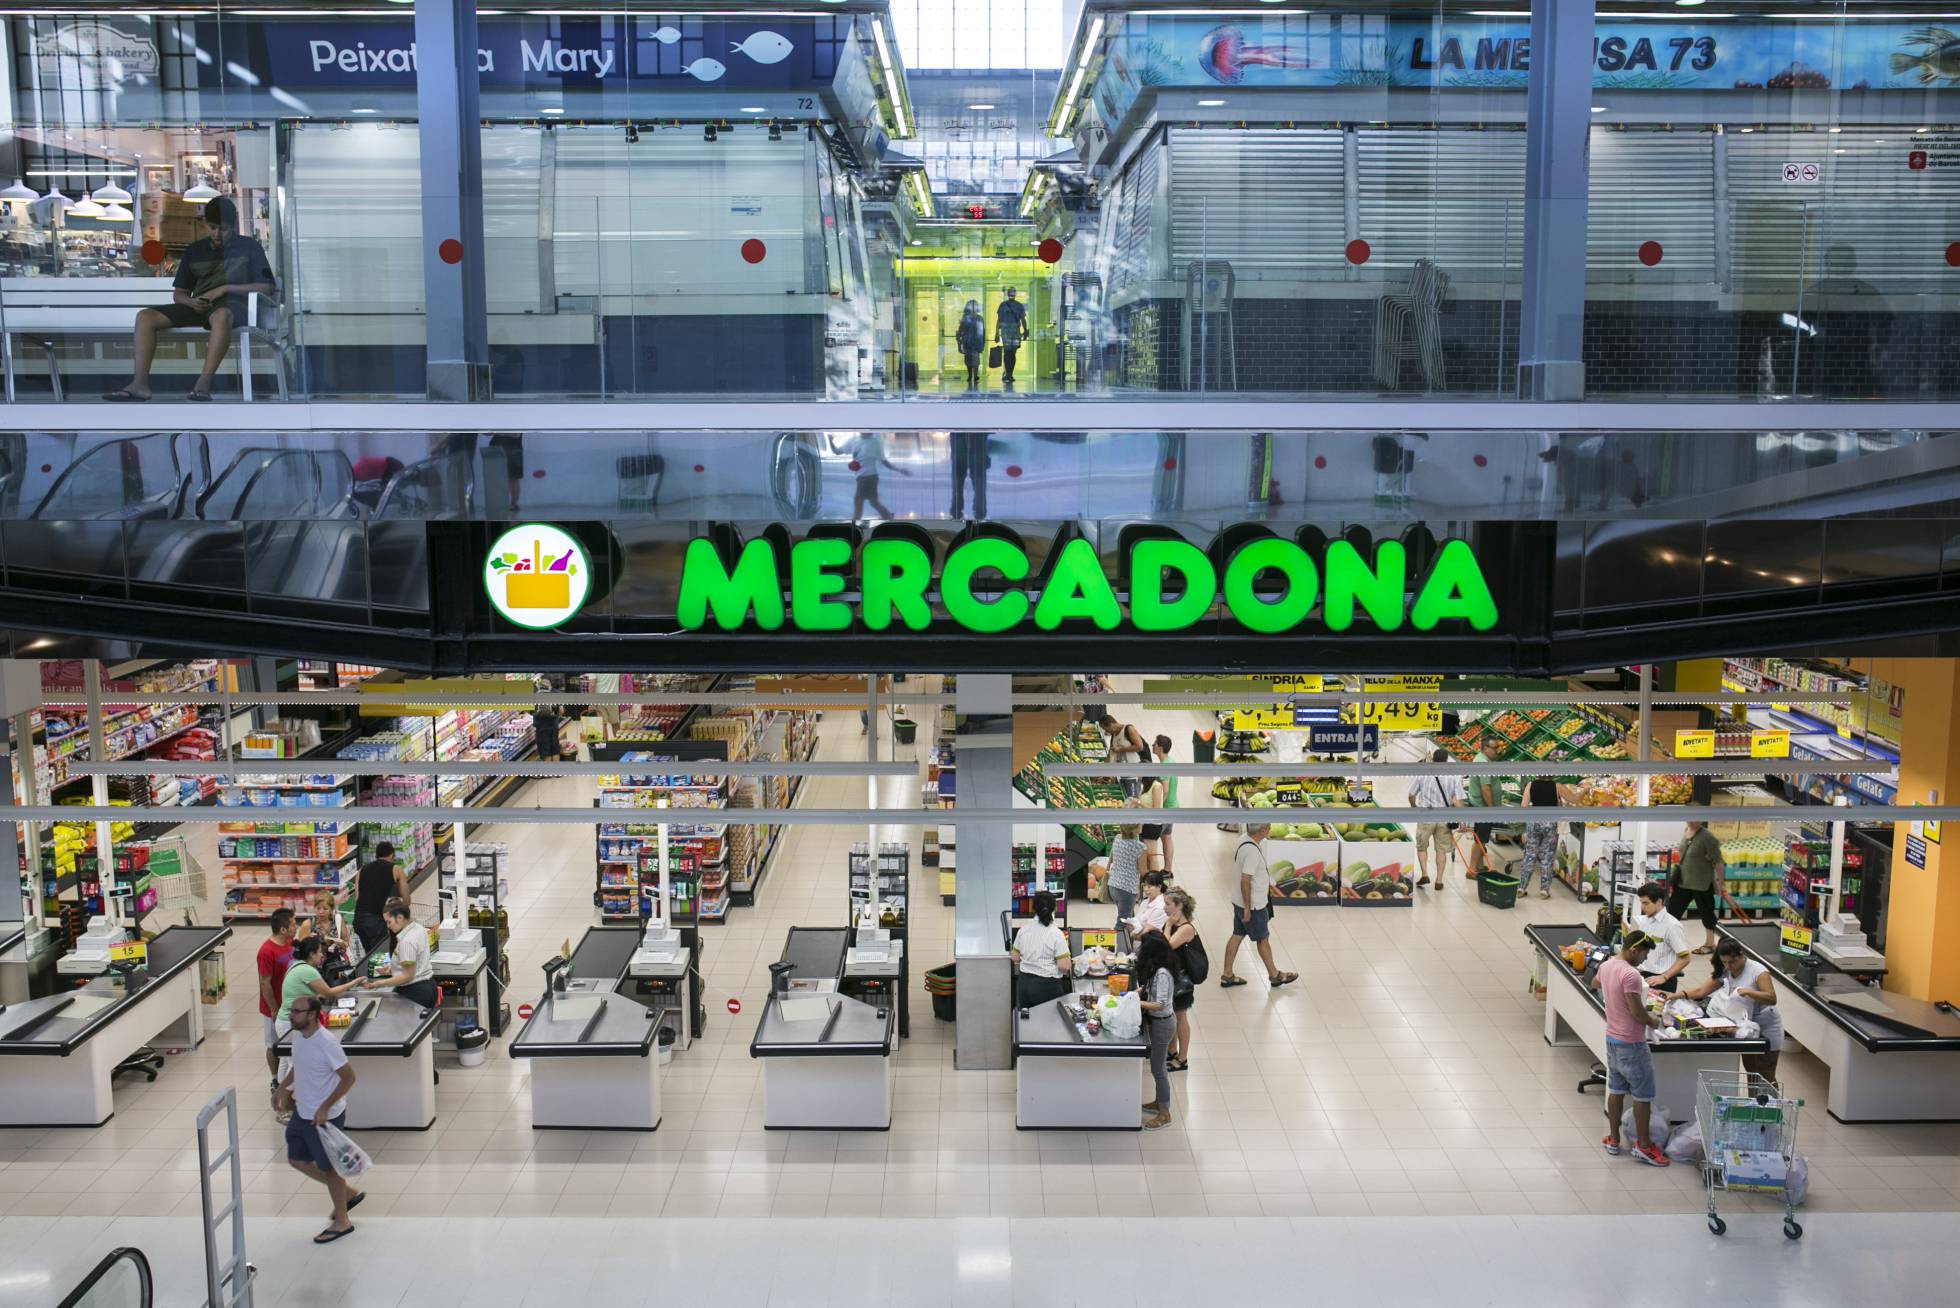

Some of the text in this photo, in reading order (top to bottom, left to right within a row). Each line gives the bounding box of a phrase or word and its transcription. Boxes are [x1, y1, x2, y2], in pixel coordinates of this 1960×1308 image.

[106, 46, 153, 61] bakery
[309, 39, 613, 78] Peixata Mary
[1410, 36, 1717, 71] LA MESA 73
[797, 98, 813, 110] 72
[677, 538, 1498, 632] MERCADONA
[1403, 676, 1440, 684] MANXA
[1427, 713, 1439, 721] kg
[1856, 776, 1884, 799] Gelats
[1096, 934, 1105, 943] 15
[1793, 930, 1802, 939] 15
[122, 946, 135, 955] 15
